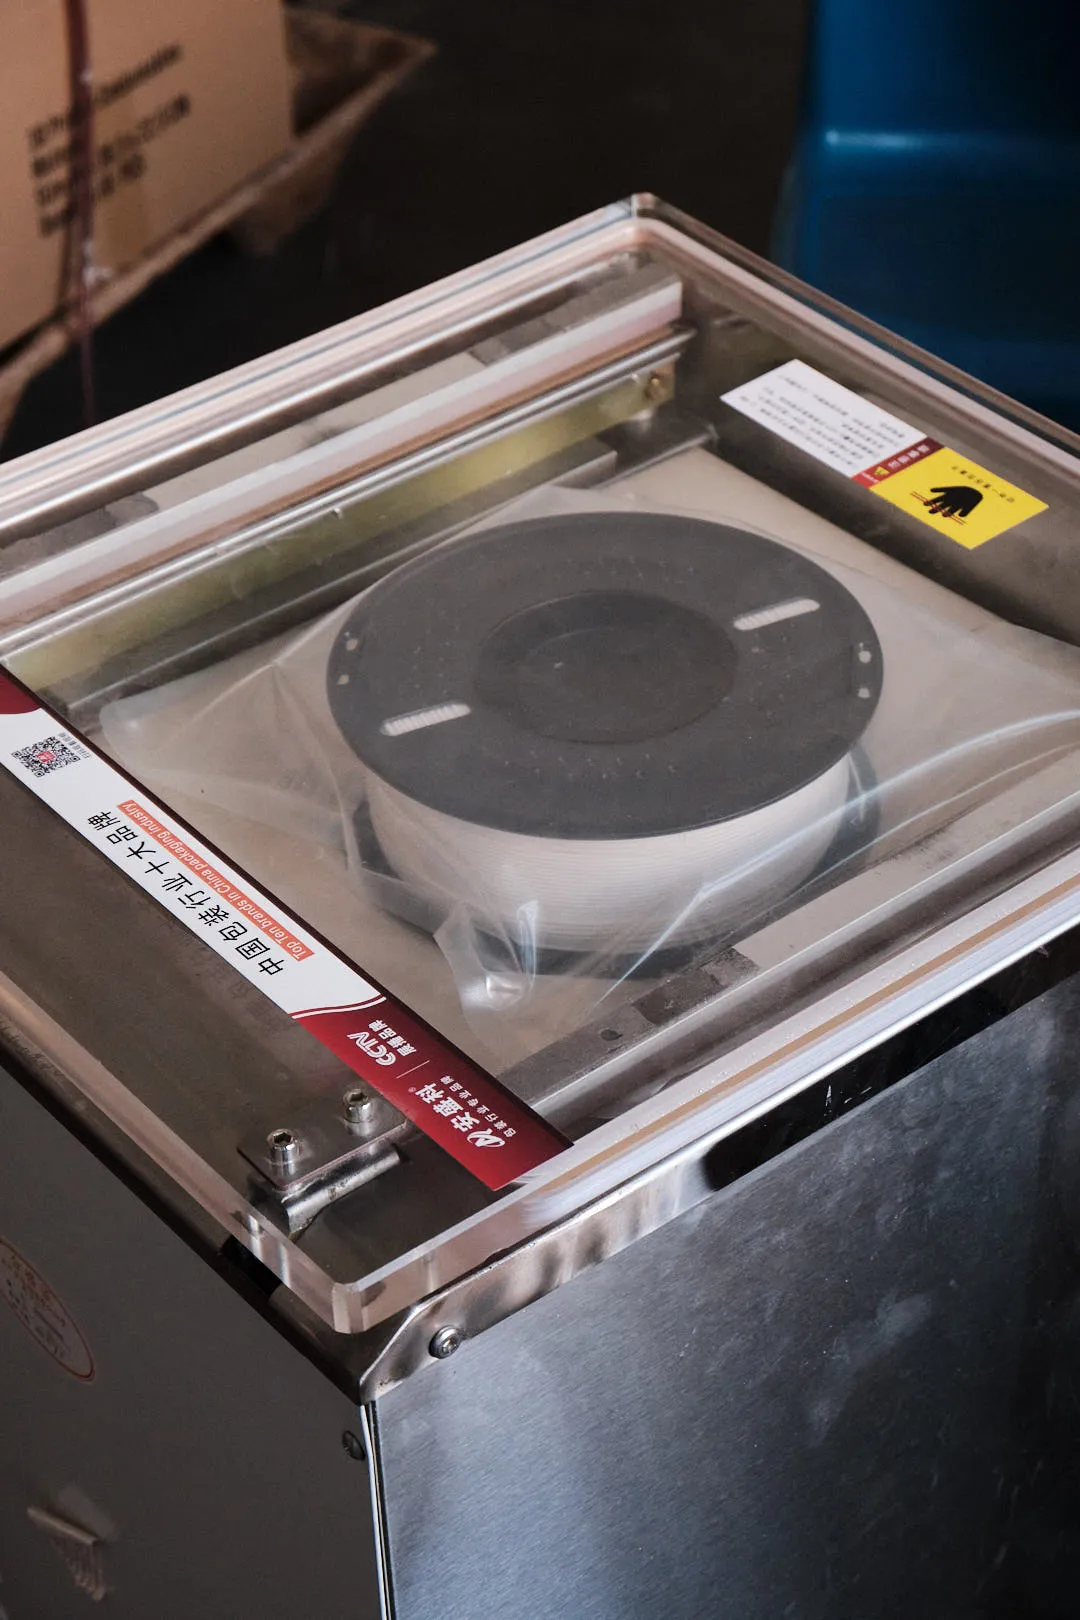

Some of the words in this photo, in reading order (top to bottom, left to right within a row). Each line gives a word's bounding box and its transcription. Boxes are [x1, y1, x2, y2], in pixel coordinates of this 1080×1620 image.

[122, 801, 161, 834] industry
[156, 829, 208, 871] packaging
[88, 809, 285, 977] 中国包装行业十大品牌
[200, 867, 231, 894] China
[226, 888, 241, 902] in
[237, 898, 272, 929] brands
[268, 924, 288, 944] Ten
[284, 939, 305, 959] Top
[346, 1030, 398, 1067] CCTV
[367, 1019, 416, 1057] 展播品牌
[439, 1074, 517, 1137] 包装行业专业品牌
